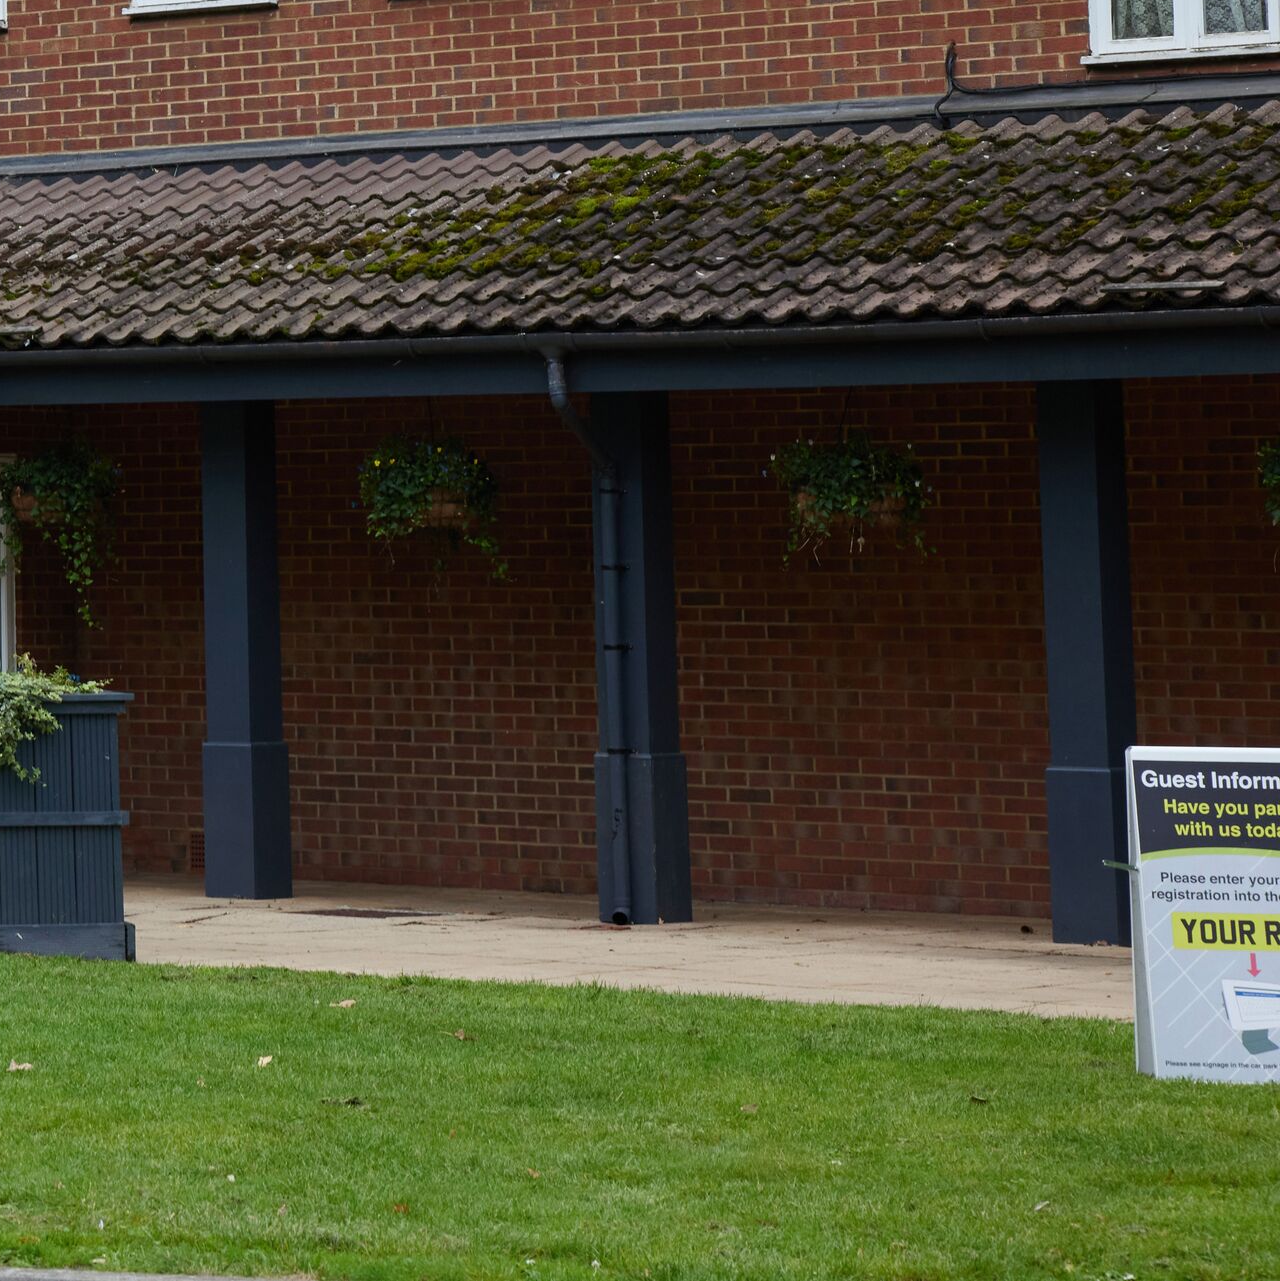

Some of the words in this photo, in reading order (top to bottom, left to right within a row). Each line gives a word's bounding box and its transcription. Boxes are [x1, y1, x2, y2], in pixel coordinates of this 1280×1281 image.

[1141, 769, 1205, 789] Guest
[1163, 798, 1210, 814] Have
[1214, 802, 1249, 818] you
[1174, 820, 1214, 837] with
[1218, 825, 1242, 838] us
[1160, 872, 1206, 884] Please
[1210, 874, 1245, 885] enter
[1249, 876, 1280, 888] your
[1151, 889, 1230, 902] registration
[1234, 890, 1261, 902] into
[1264, 891, 1280, 902] th
[1180, 918, 1256, 945] YOUR
[1264, 920, 1280, 946] R
